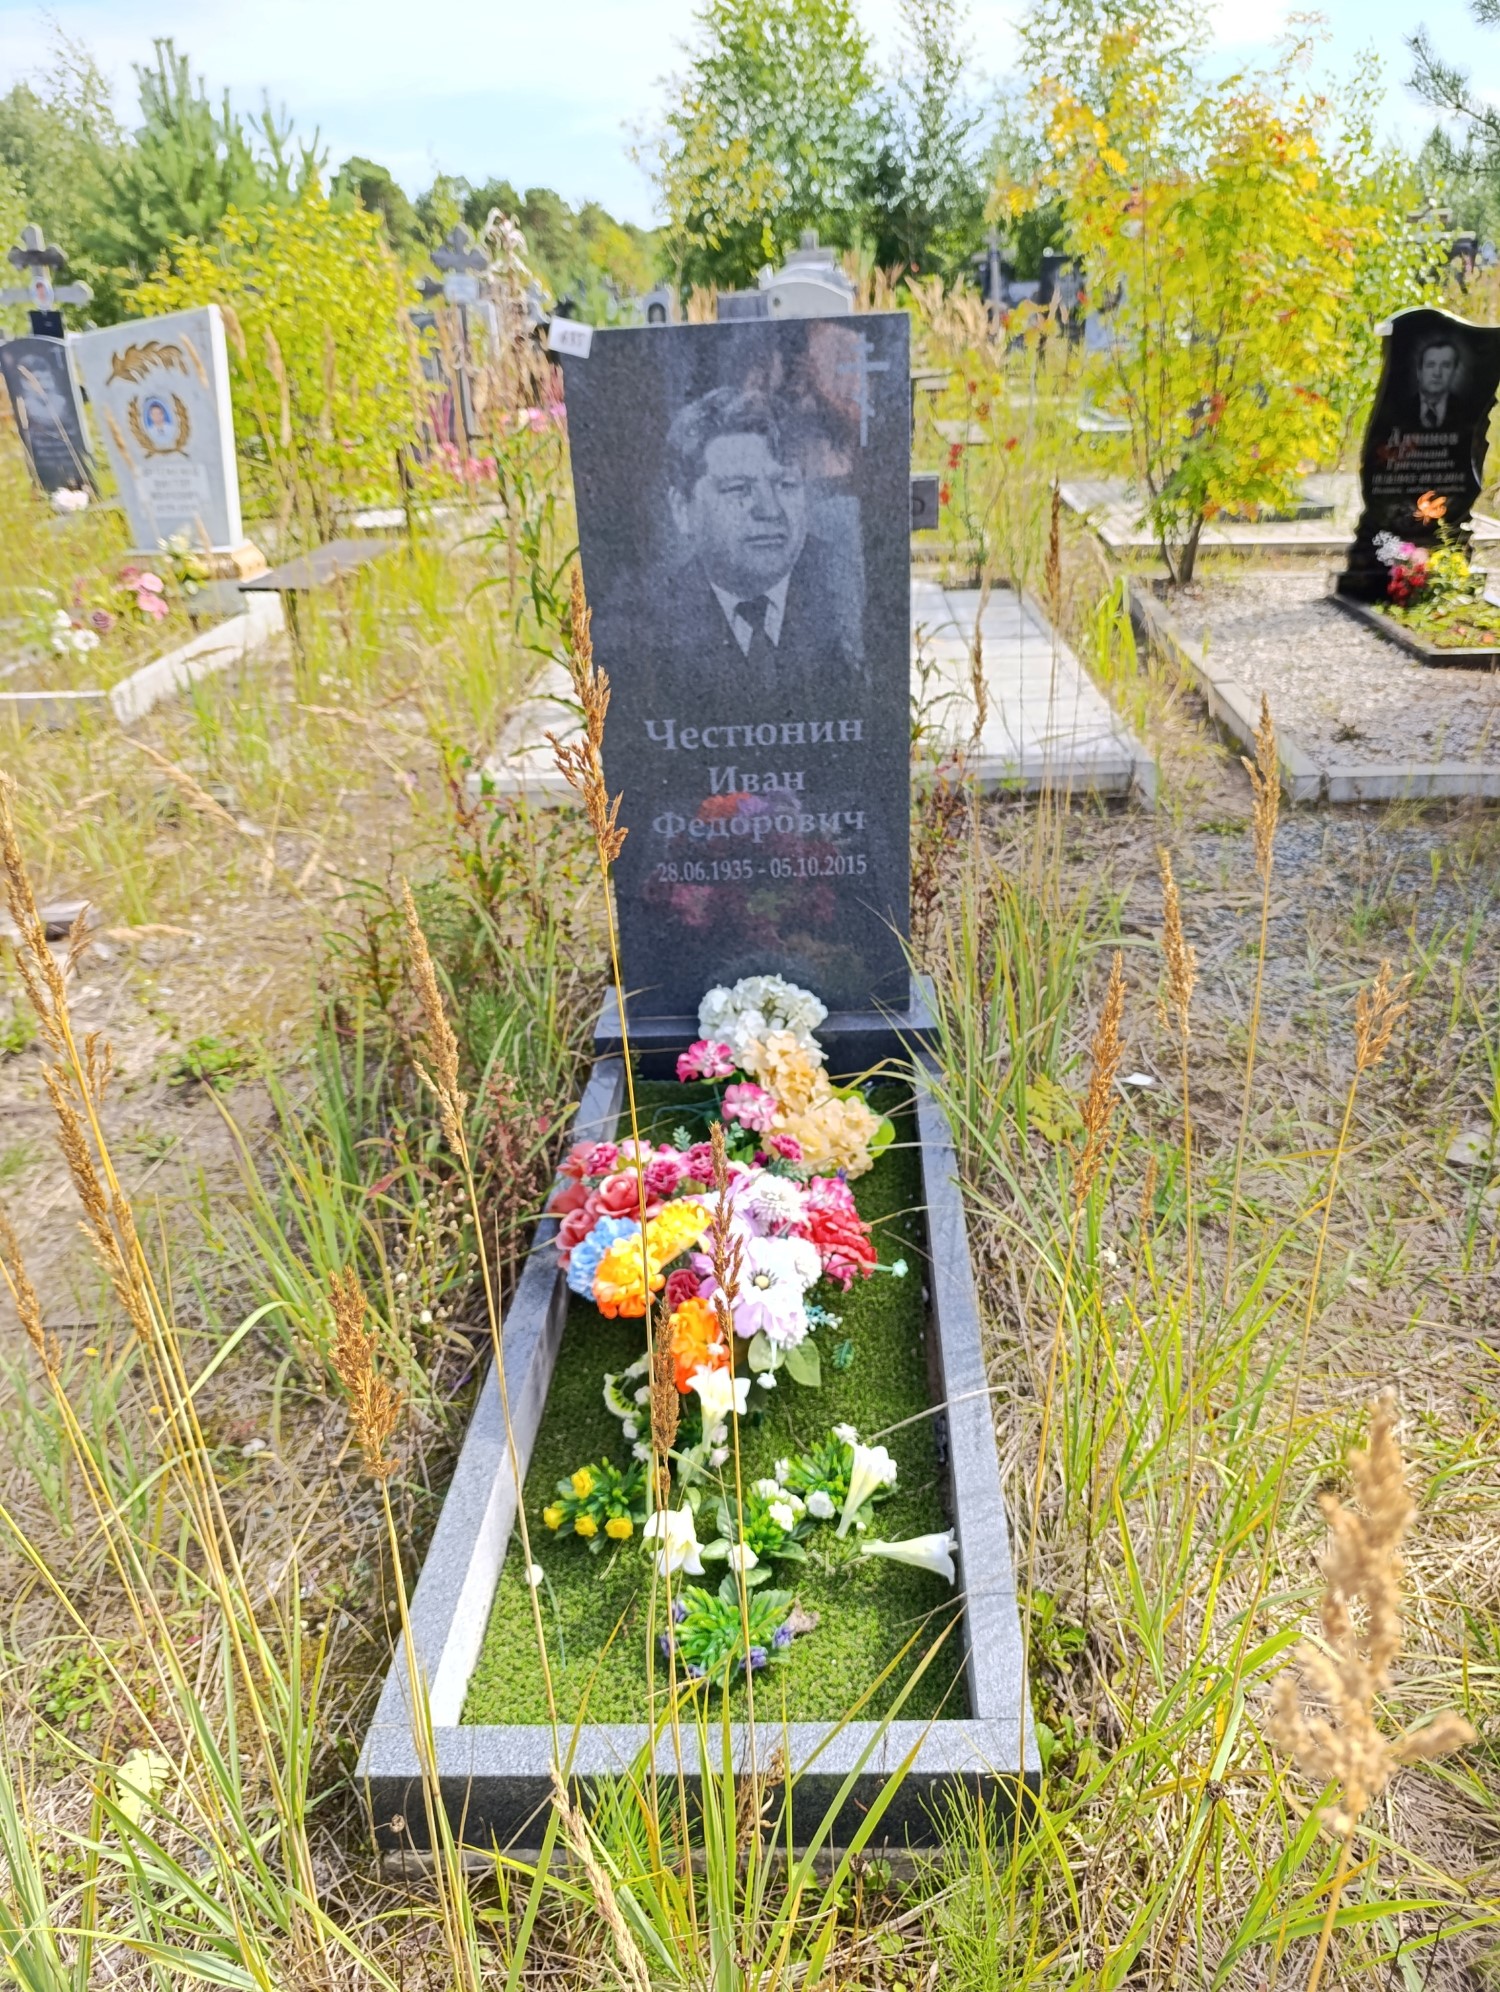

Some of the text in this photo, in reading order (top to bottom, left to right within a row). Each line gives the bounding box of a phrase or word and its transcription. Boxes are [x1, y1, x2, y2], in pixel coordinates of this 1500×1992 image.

[644, 719, 864, 750] Честюнин
[707, 766, 805, 794] Иван
[652, 811, 865, 843] Федорович
[656, 860, 753, 883] 28.06.1935
[770, 854, 867, 878] 05.10.2015
